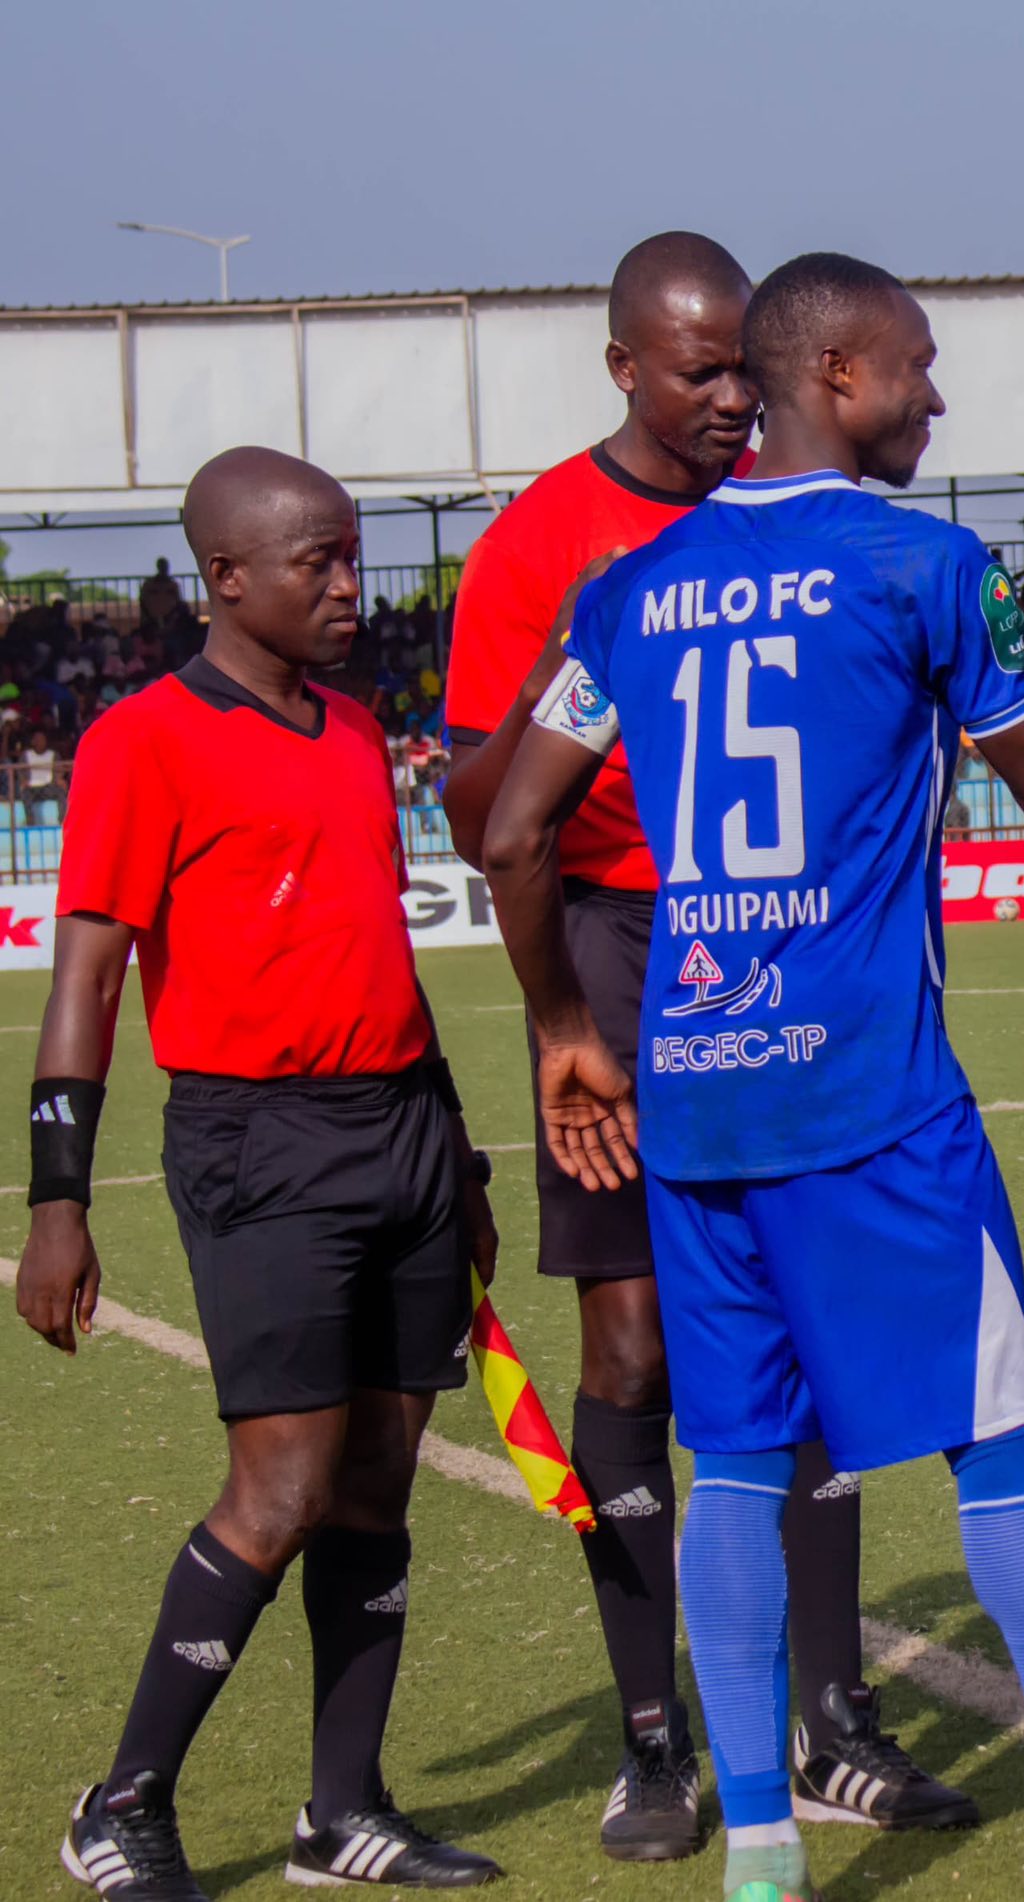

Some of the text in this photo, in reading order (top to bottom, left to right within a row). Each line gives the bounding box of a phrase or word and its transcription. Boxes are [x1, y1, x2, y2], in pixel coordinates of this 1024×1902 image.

[642, 569, 835, 636] MILO FC
[667, 635, 805, 883] 15
[653, 1024, 827, 1072] BEGEC-TP
[598, 1500, 662, 1518] adidas
